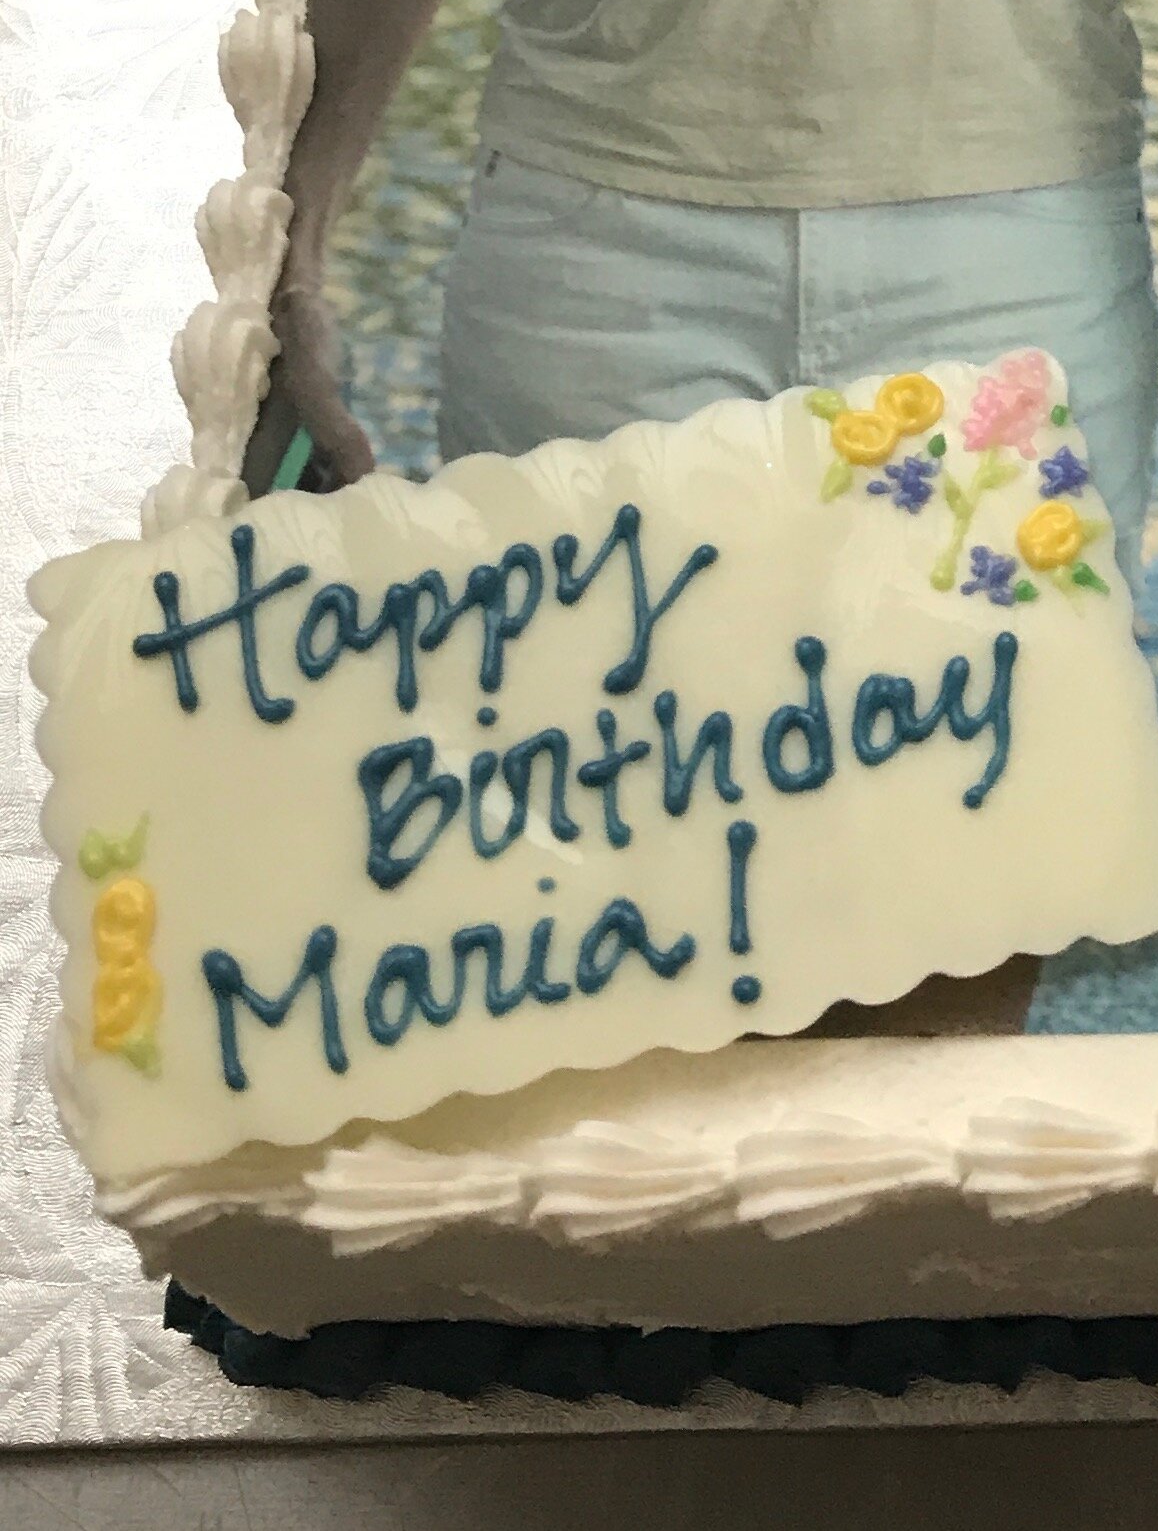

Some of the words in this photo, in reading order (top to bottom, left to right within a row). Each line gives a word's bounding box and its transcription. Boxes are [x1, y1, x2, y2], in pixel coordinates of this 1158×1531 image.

[132, 503, 719, 725] Happy
[356, 630, 1019, 892] Birthday
[200, 820, 763, 1093] Maria!
